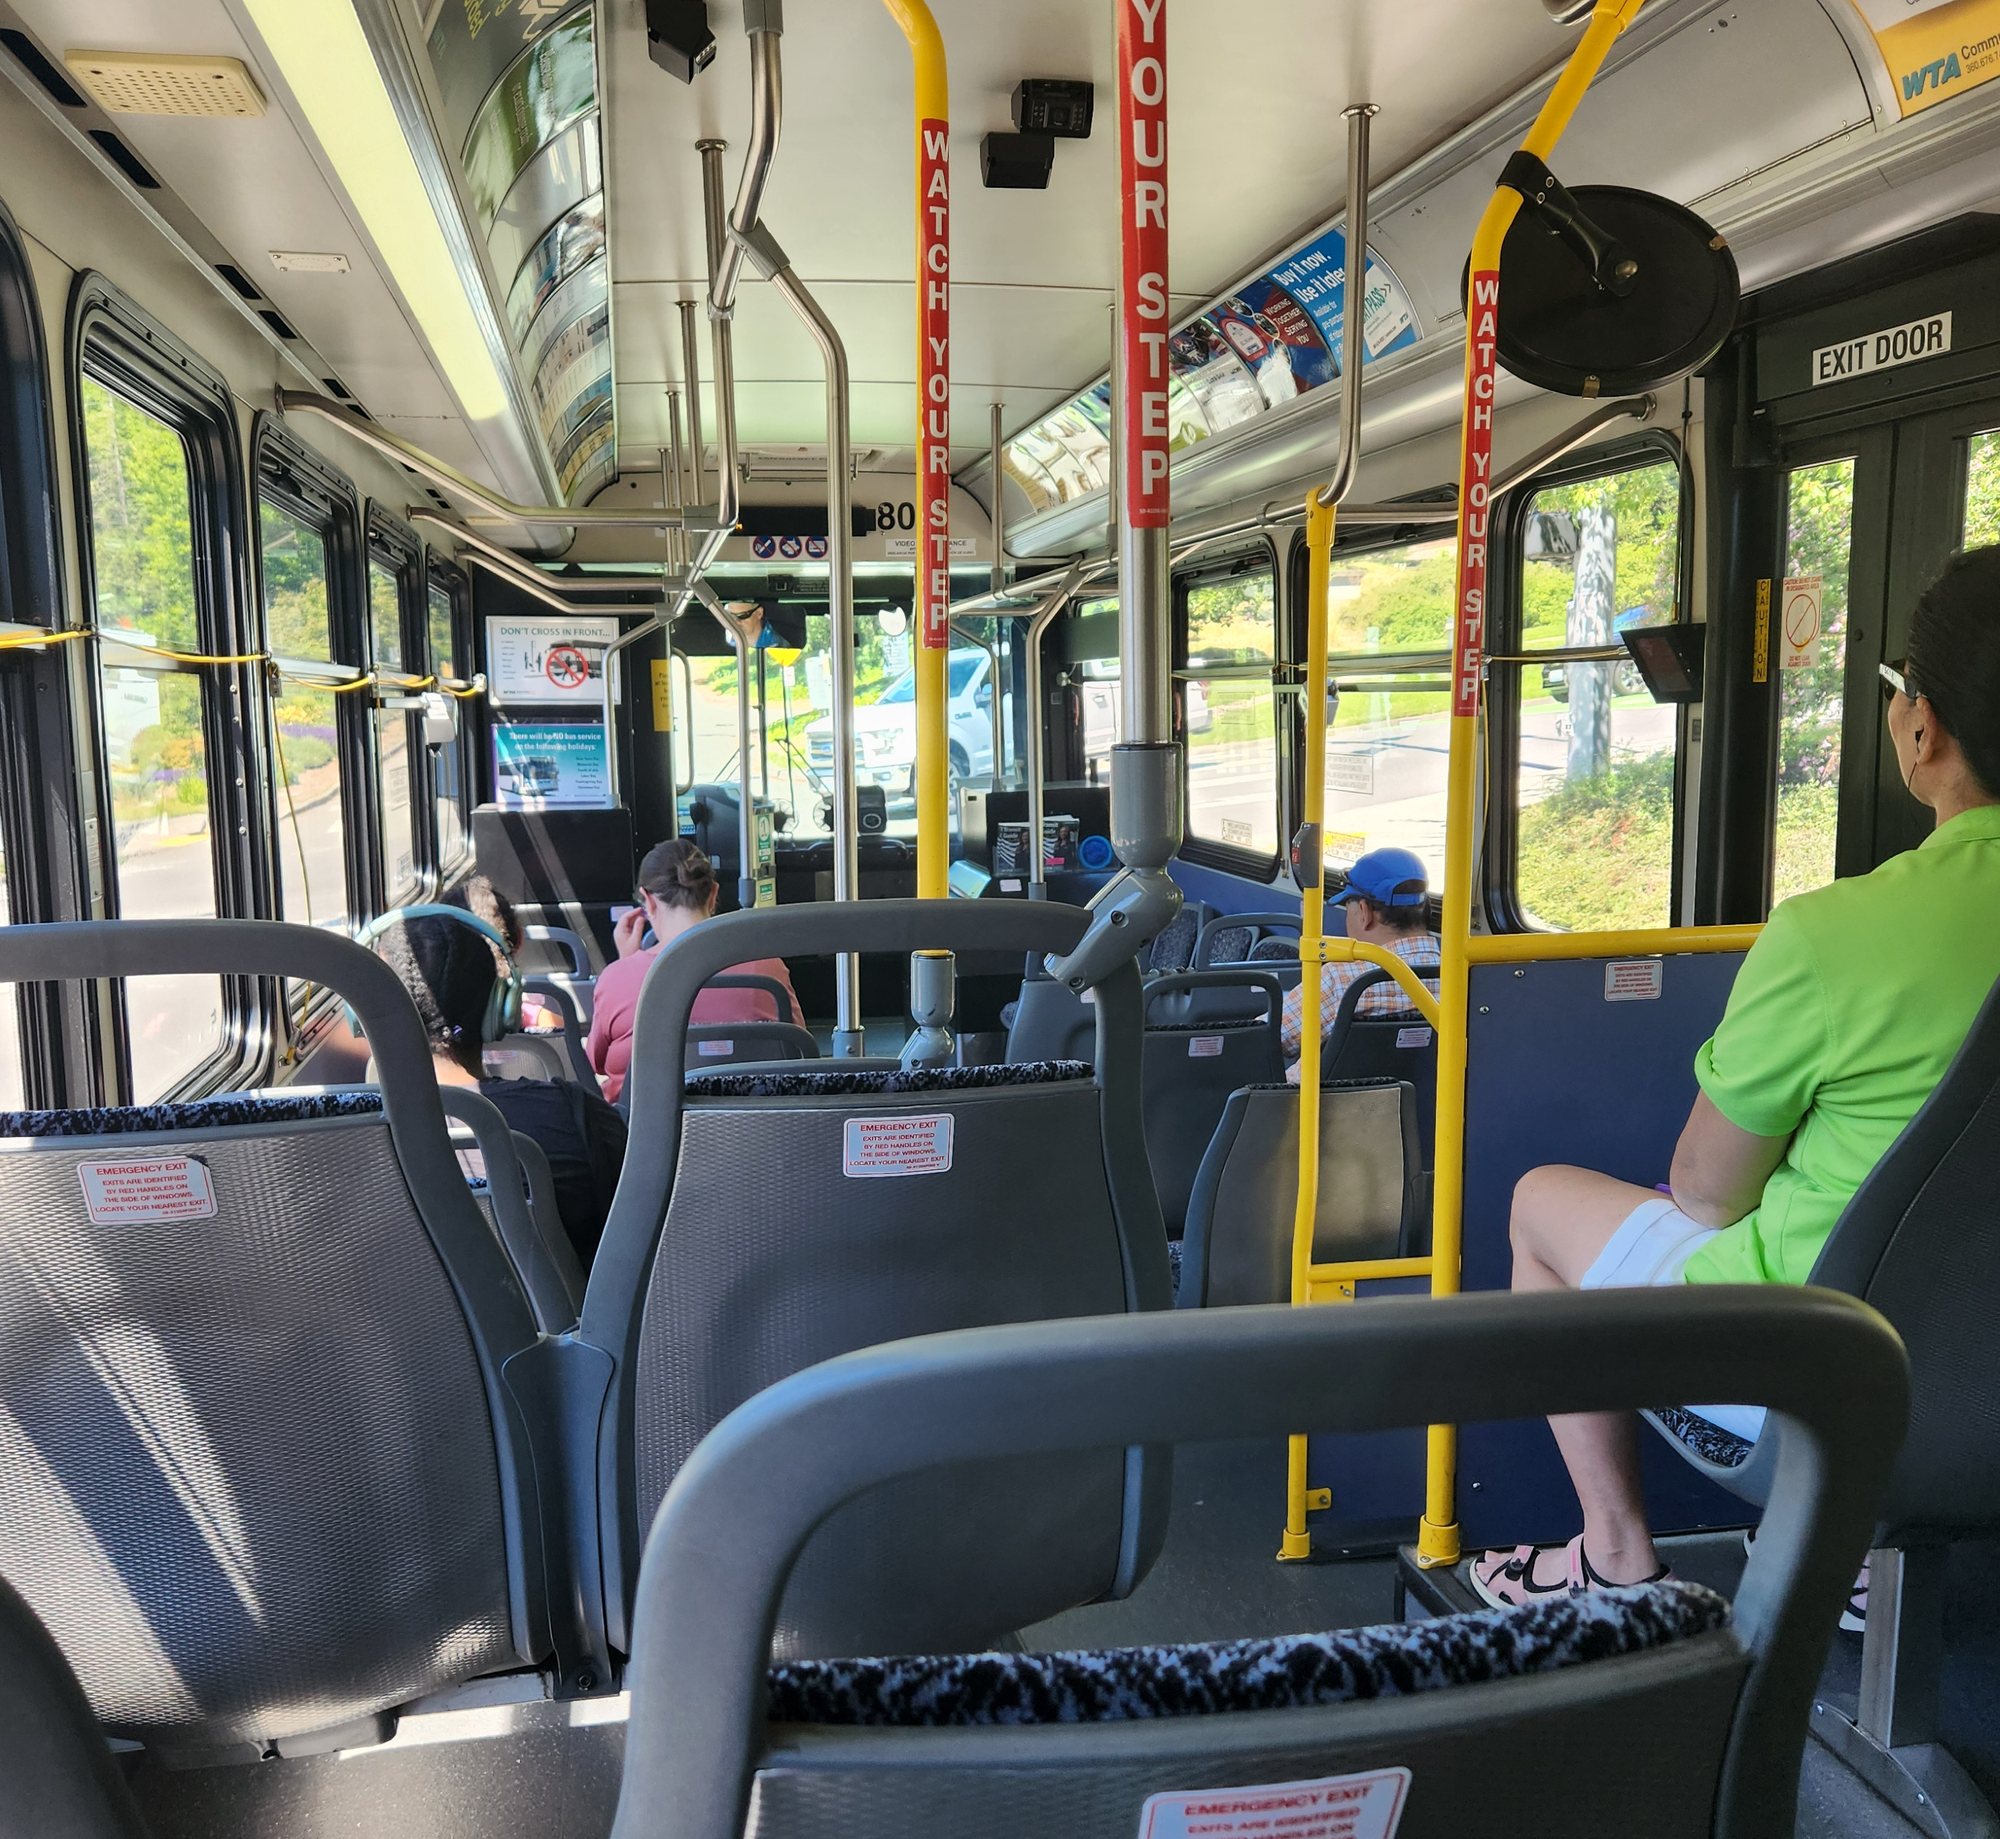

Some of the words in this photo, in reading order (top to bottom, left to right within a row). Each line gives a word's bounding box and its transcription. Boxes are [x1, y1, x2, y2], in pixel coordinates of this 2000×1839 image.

[1902, 52, 1962, 100] WTA
[1961, 33, 2000, 60] Comm
[1966, 50, 2000, 74] 360.676.7
[1131, 0, 1166, 229] YOUR
[923, 130, 949, 311] WATCH
[1272, 268, 1302, 287] Buy
[1300, 250, 1332, 271] now.
[1293, 285, 1319, 303] Use
[1264, 298, 1291, 315] WORKING
[1273, 307, 1302, 325] TOGETHER
[1284, 319, 1308, 336] SERVING
[1296, 333, 1310, 345] YOU
[1474, 280, 1499, 430] WATCH
[1820, 340, 1868, 380] EXIT
[1876, 319, 1943, 366] DOOR
[1136, 272, 1168, 495] STEP
[928, 337, 949, 474] YOUR
[1467, 452, 1490, 567] YOUR
[929, 499, 948, 630] STEP
[500, 627, 529, 635] DON'T
[531, 628, 560, 636] CROSS
[562, 628, 572, 636] IN
[574, 628, 611, 637] FRONT...
[1757, 580, 1767, 678] CAUTION
[1461, 588, 1482, 701] STEP
[509, 732, 528, 740] There
[530, 732, 546, 740] will
[553, 732, 564, 740] NO
[565, 732, 576, 740] bus
[536, 743, 567, 751] following
[568, 743, 596, 751] holidays:
[860, 1122, 917, 1131] EMERGENCY
[899, 1132, 935, 1140] IDENTIFIED
[96, 1164, 163, 1176] EMERGENCY
[165, 1162, 188, 1171] EXIT
[143, 1174, 188, 1184] IDENTIFIED
[137, 1185, 175, 1193] HANDLES
[151, 1201, 188, 1210] NEAREST
[1185, 1792, 1323, 1816] EMERGENCY
[1327, 1785, 1374, 1804] EXIT
[1187, 1822, 1234, 1834] EXITS
[1238, 1819, 1270, 1831] ARE
